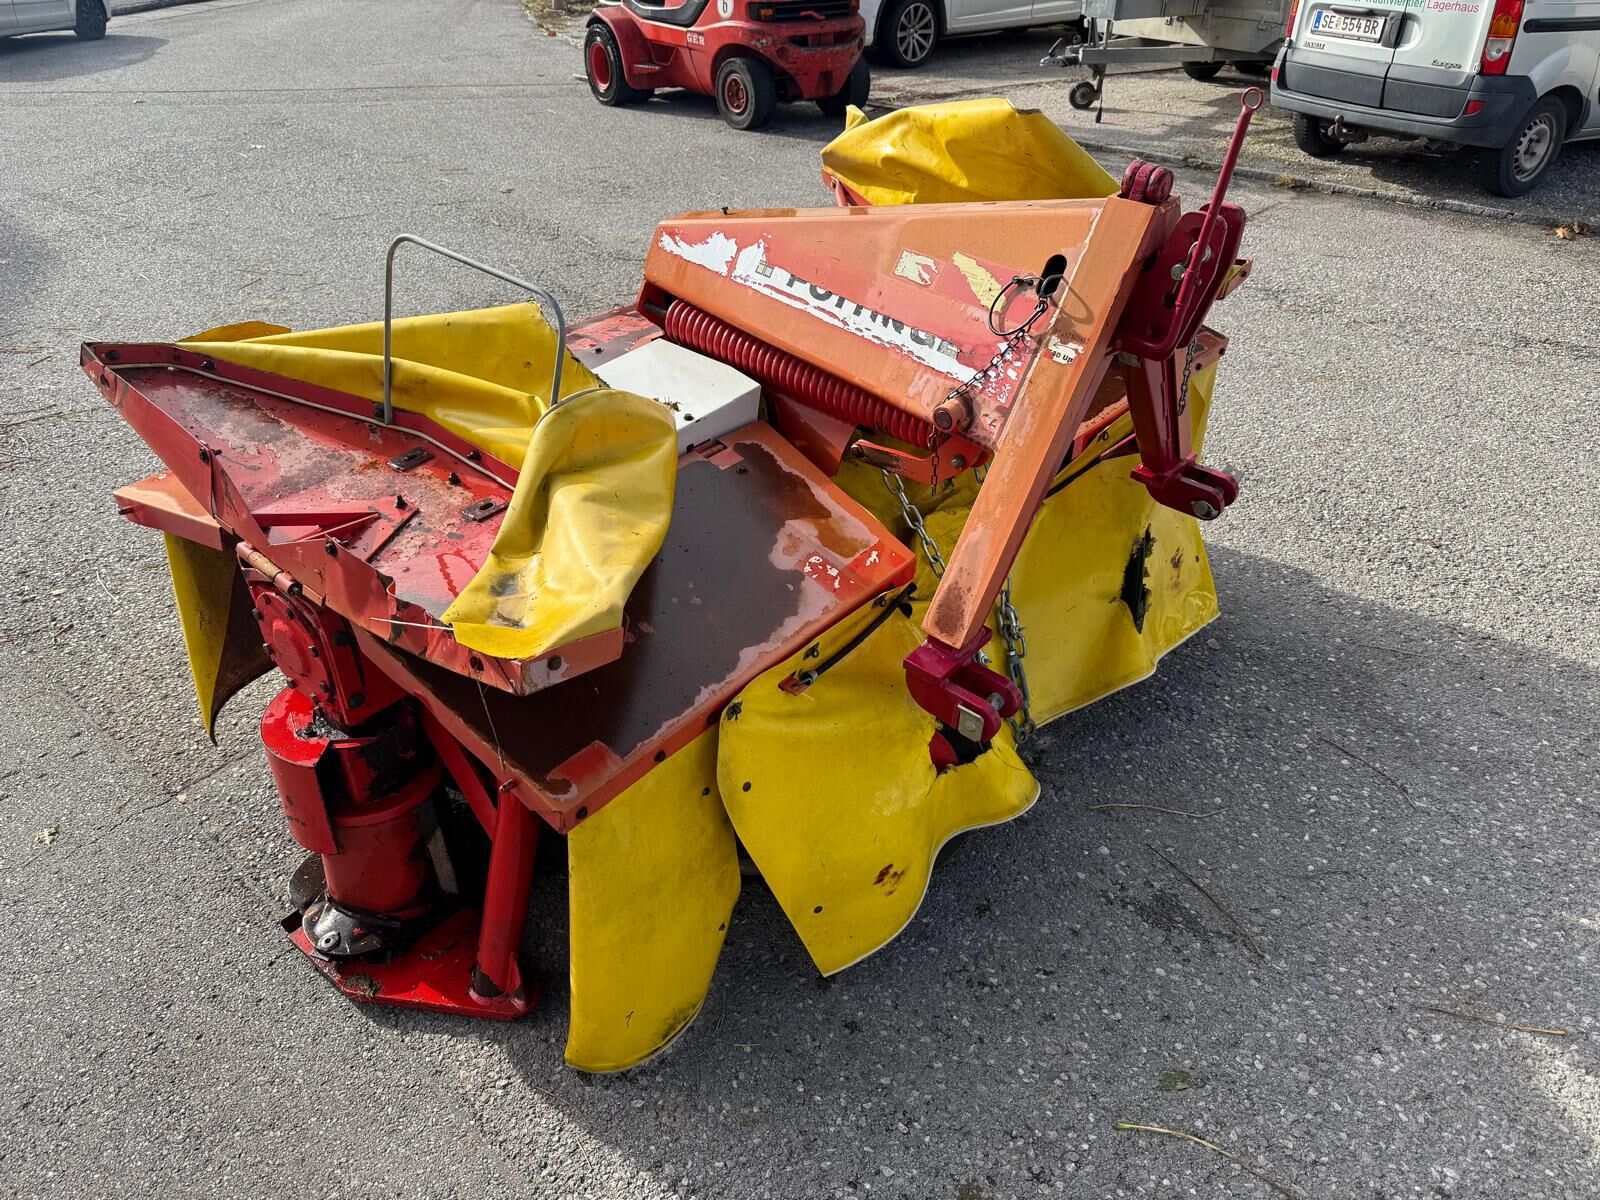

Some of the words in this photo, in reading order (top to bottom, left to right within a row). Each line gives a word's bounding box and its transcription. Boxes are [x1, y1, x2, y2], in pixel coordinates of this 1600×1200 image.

[1427, 0, 1480, 13] Lagerhaus
[1321, 14, 1336, 29] SE
[1341, 16, 1362, 33] 554
[1363, 19, 1379, 35] BR
